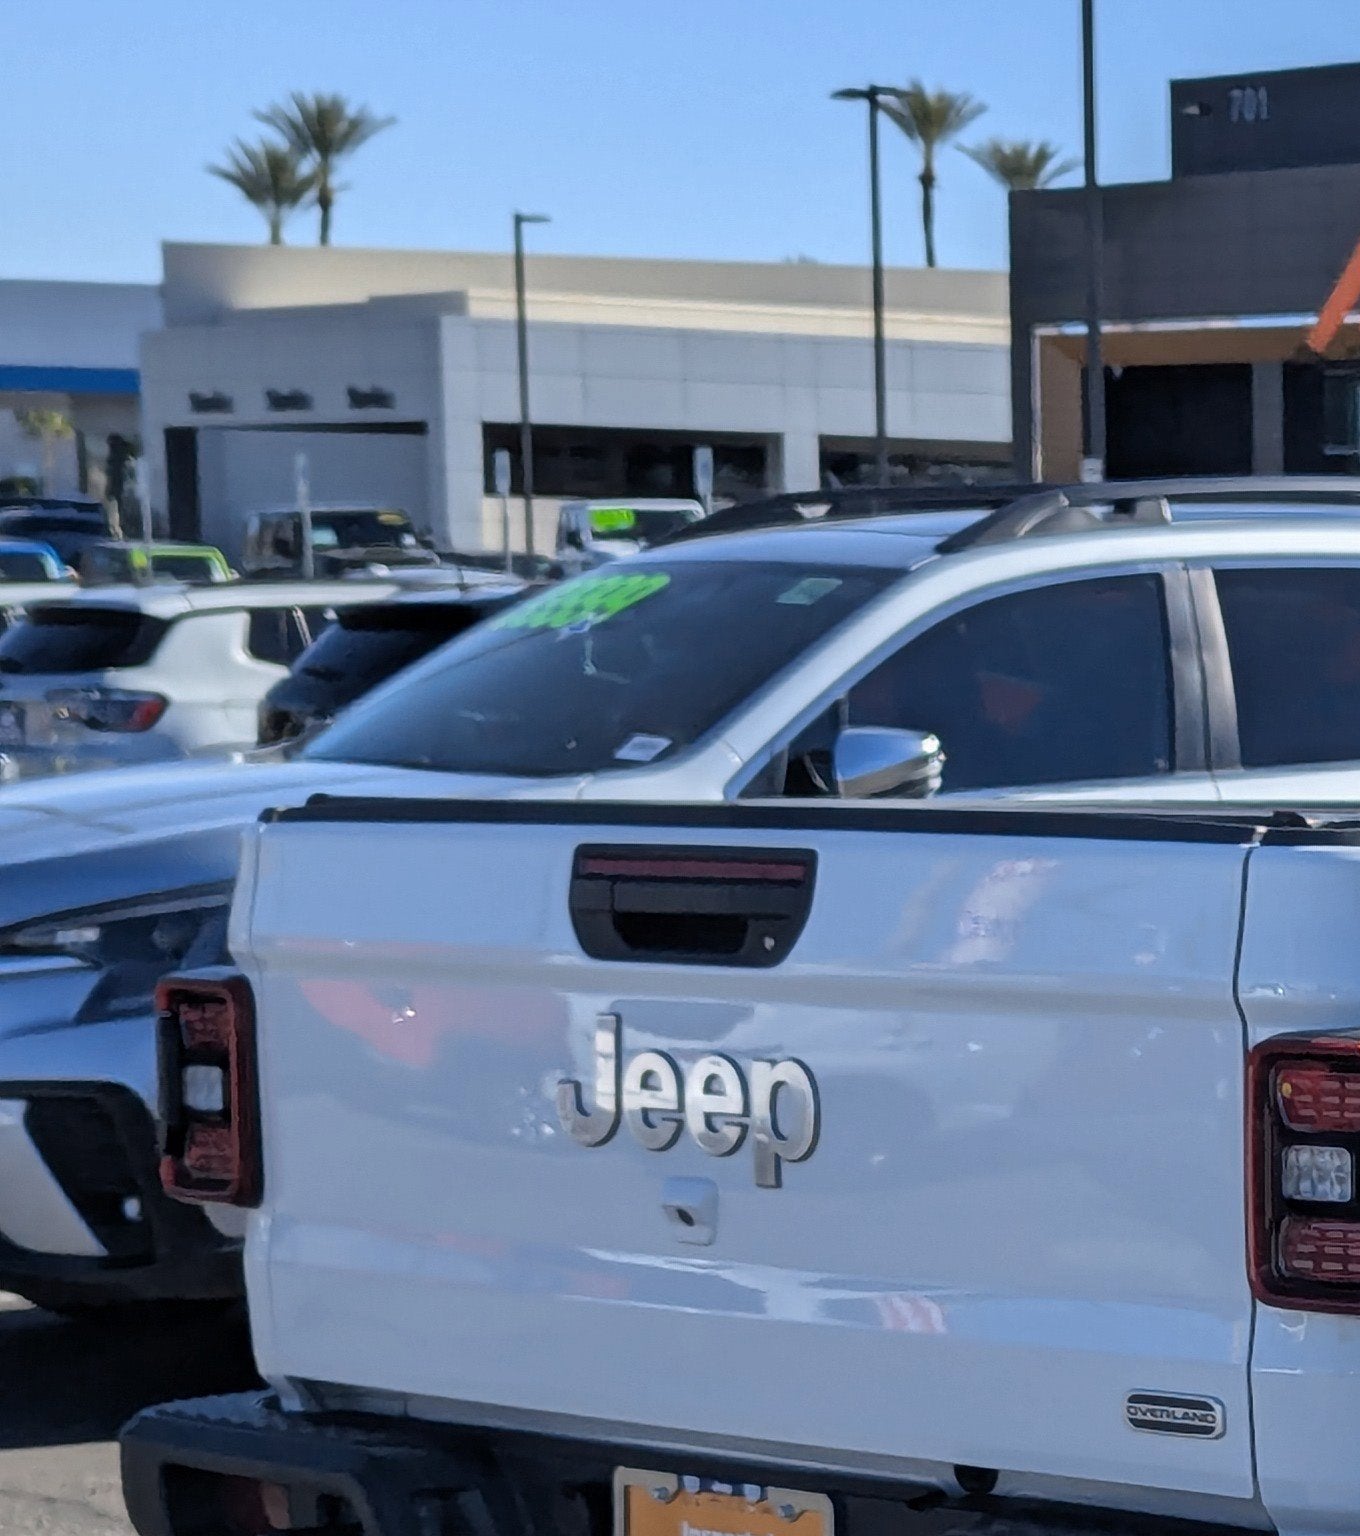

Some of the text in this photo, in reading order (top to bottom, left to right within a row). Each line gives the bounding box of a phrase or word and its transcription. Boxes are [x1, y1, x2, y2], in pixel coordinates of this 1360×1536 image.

[1230, 86, 1268, 122] 701
[557, 1011, 821, 1188] Jeep
[1126, 1405, 1217, 1424] OVERLAND
